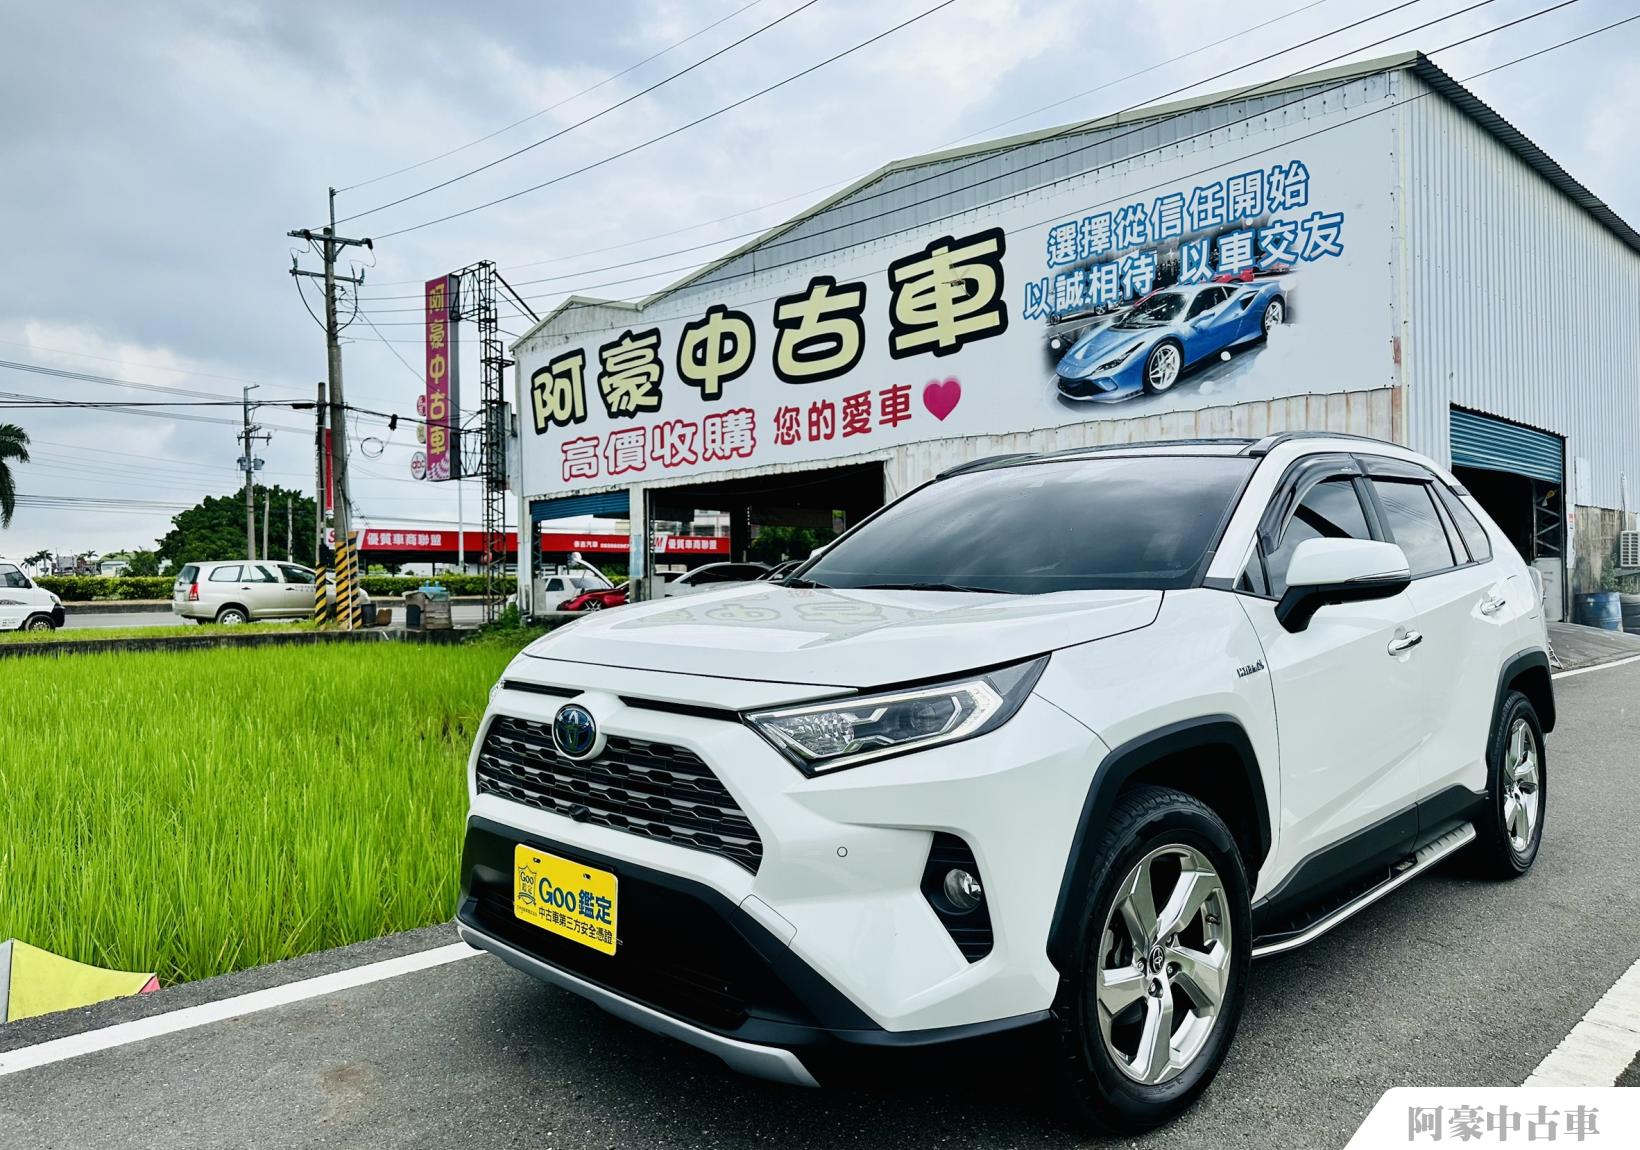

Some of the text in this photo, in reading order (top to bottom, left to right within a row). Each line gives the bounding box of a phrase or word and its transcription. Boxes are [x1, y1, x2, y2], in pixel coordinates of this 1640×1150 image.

[1023, 211, 1345, 321] 以誠相待 以車交友
[1047, 159, 1310, 268] 選擇從信任開始
[429, 283, 447, 456] 阿豪中古車
[531, 226, 1008, 435] 阿豪中古車
[560, 384, 913, 483] 高價收購 您的愛車
